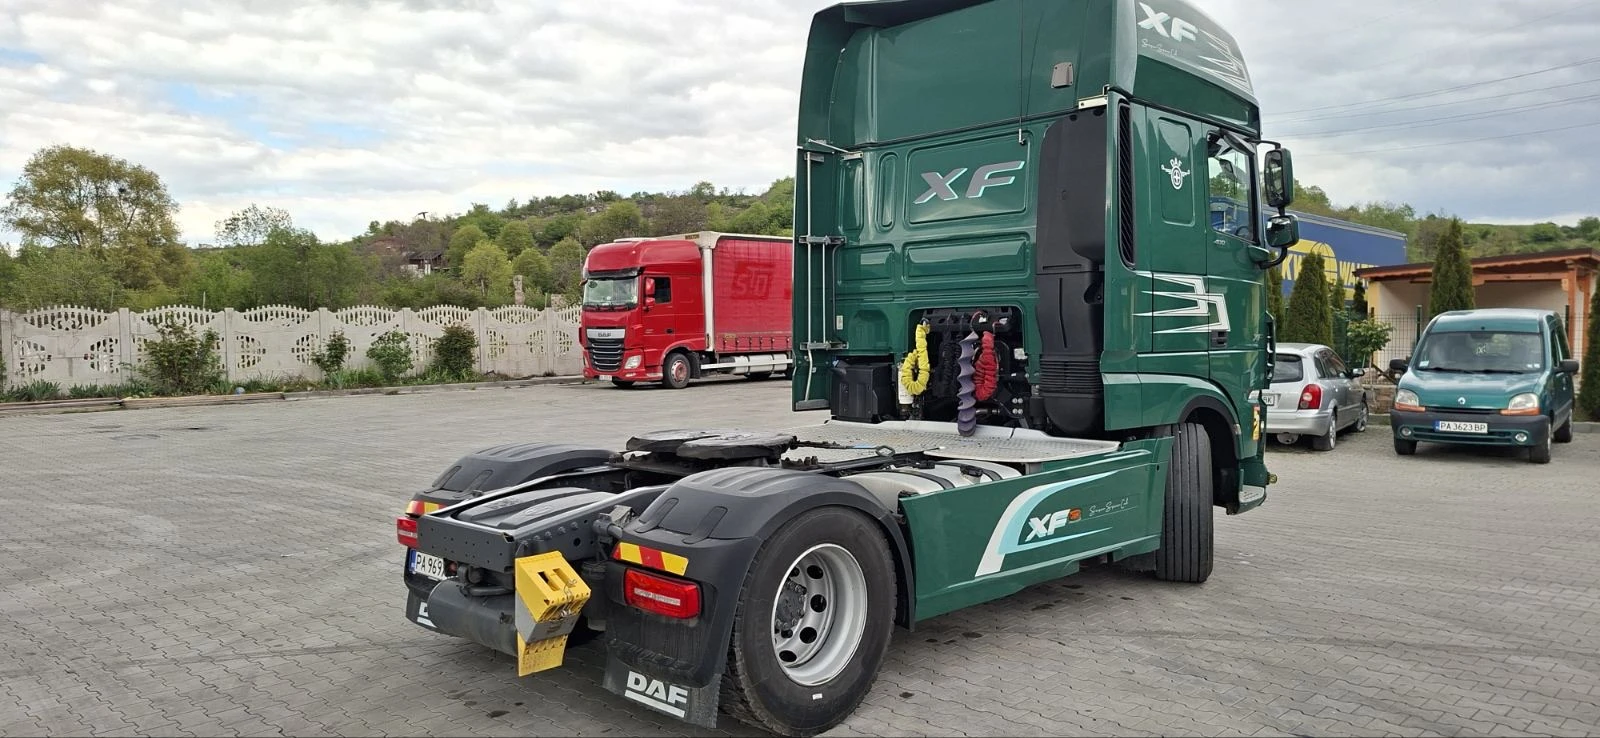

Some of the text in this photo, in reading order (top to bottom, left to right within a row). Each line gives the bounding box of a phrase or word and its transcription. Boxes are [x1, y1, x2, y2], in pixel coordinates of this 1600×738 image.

[1138, 2, 1198, 42] XF
[913, 160, 1025, 204] XF
[1453, 423, 1473, 431] 3623
[1025, 509, 1071, 542] XF
[416, 554, 445, 577] PA 969
[626, 670, 689, 705] DAF
